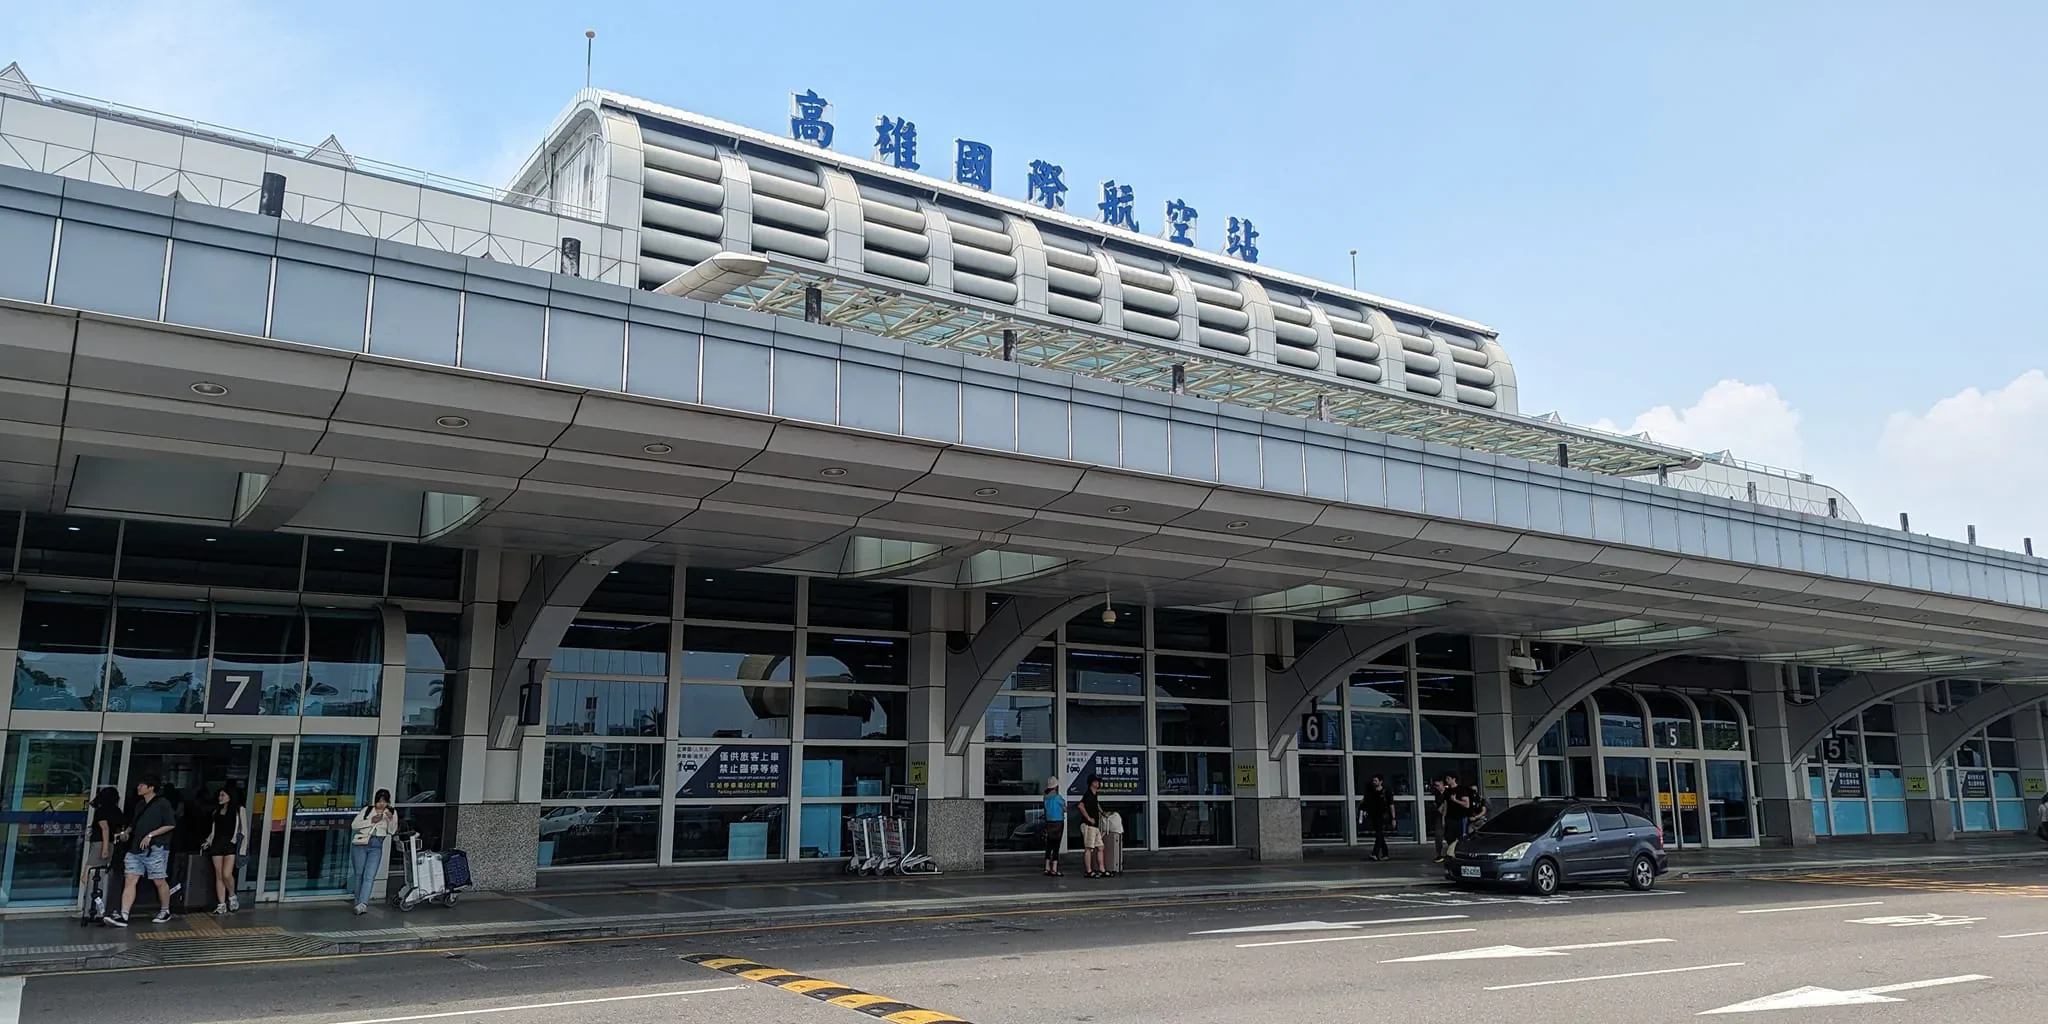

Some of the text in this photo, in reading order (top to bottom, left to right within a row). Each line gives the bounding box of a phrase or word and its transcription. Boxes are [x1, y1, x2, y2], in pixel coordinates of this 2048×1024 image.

[791, 88, 1260, 264] 高雄國際航空站
[225, 676, 250, 709] 7
[1306, 715, 1319, 742] 6
[1669, 727, 1678, 746] 5
[719, 751, 779, 762] 僅供旅客上車
[1828, 739, 1841, 759] 5
[719, 763, 779, 774] 禁止臨停等候
